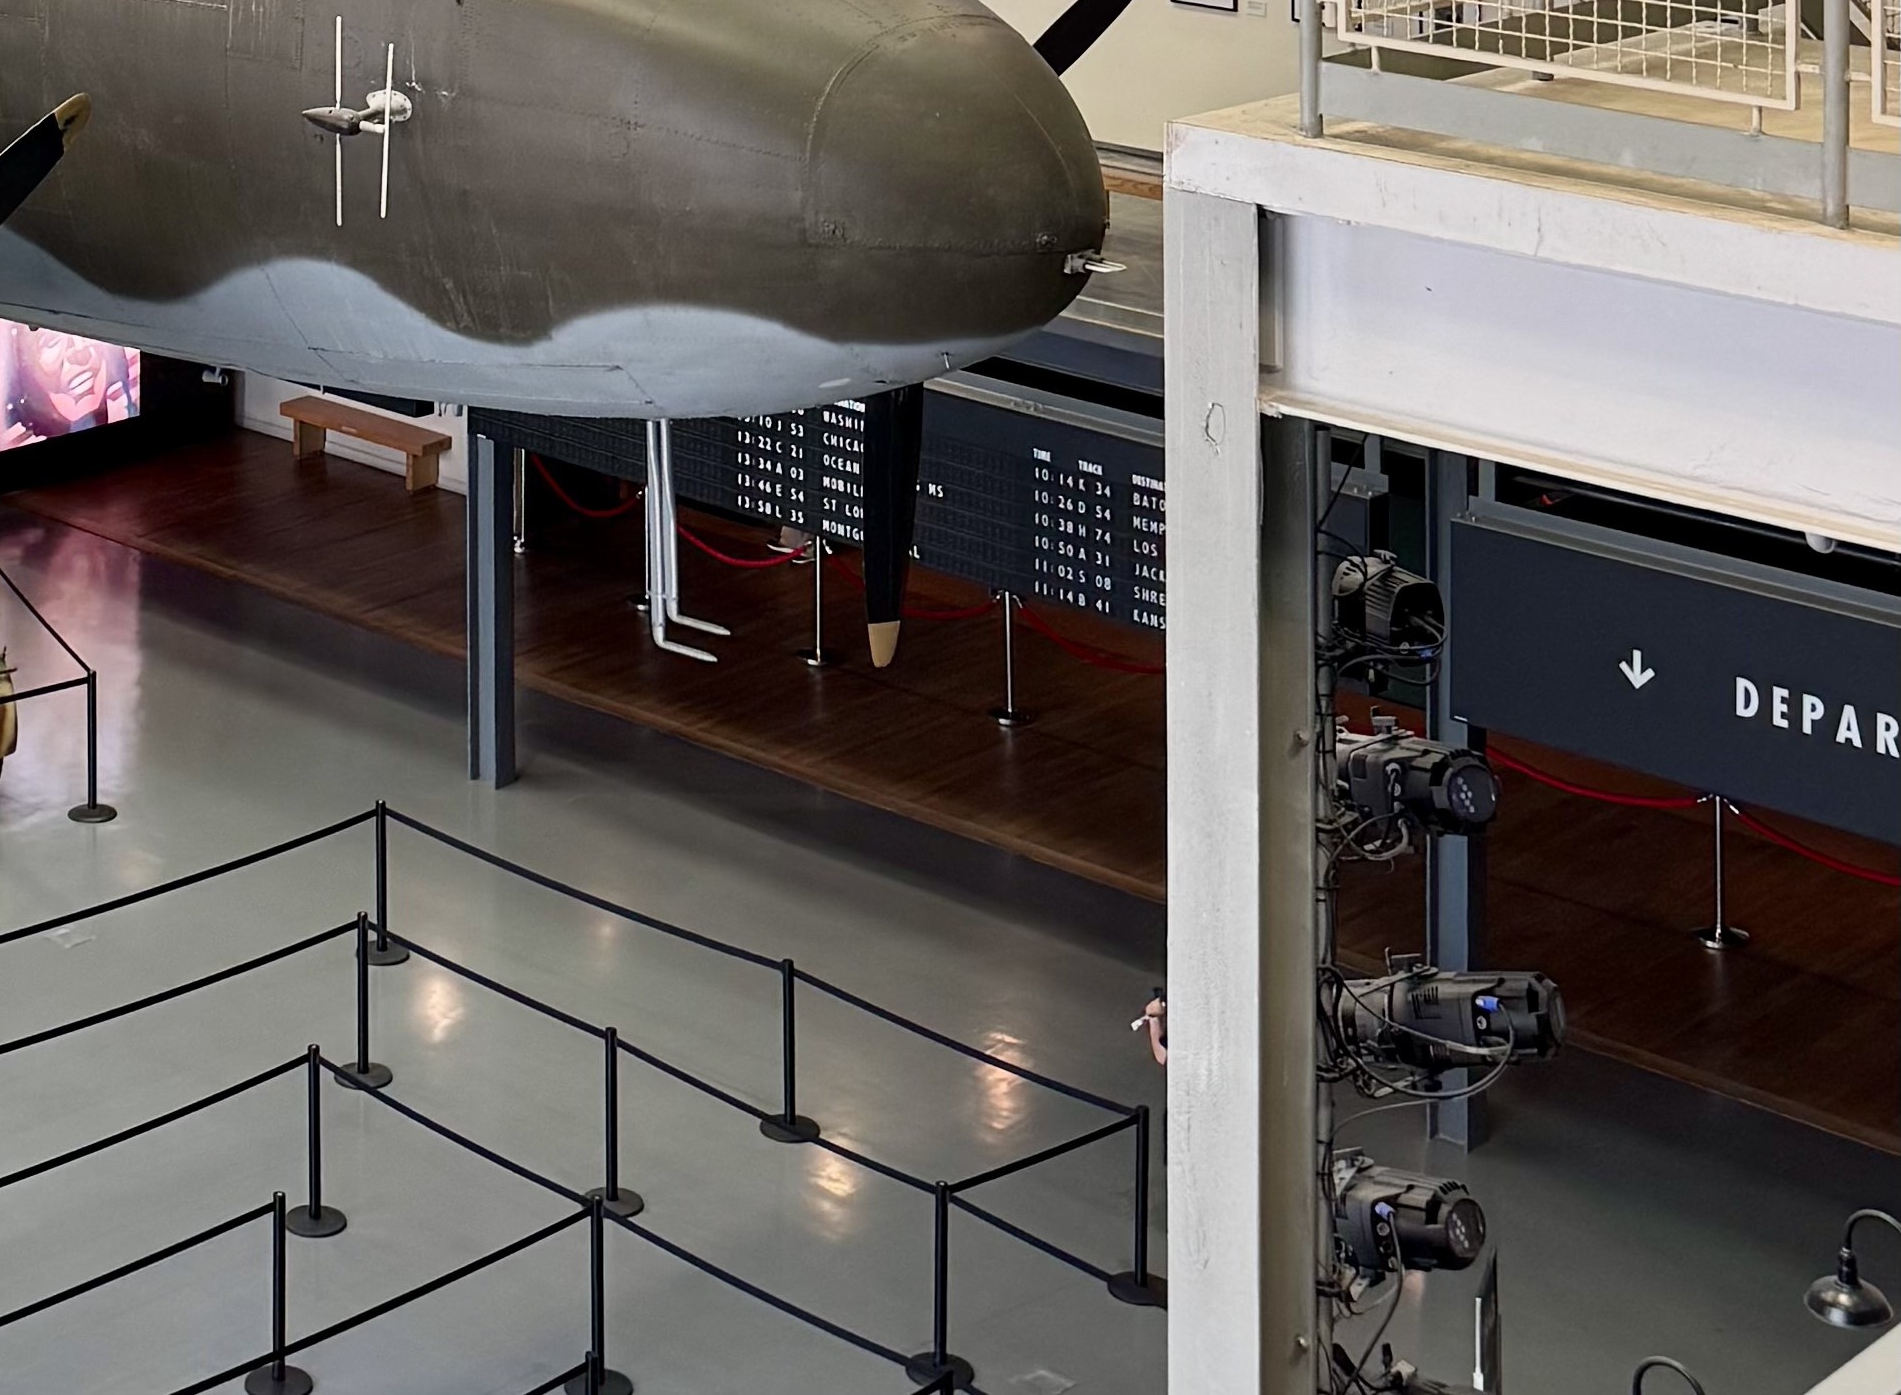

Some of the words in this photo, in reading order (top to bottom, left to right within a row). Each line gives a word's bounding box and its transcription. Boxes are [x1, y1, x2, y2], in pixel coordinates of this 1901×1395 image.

[823, 454, 860, 475] OCEAN
[1032, 447, 1051, 463] TIME
[1078, 460, 1103, 475] TRACK
[1132, 474, 1166, 491] DESTINA
[775, 462, 783, 475] A
[823, 476, 864, 497] MOBIL
[1078, 478, 1086, 492] K
[1095, 482, 1111, 498] 34
[775, 484, 783, 497] E
[823, 497, 837, 512] ST
[775, 505, 782, 518] L
[1133, 515, 1166, 536] MEMP
[1095, 528, 1111, 545] 74
[1133, 539, 1158, 557] LOS
[1078, 547, 1086, 561] A
[1095, 552, 1110, 567] 31
[1078, 570, 1086, 583] S
[1133, 586, 1166, 606] SHRE
[1095, 599, 1110, 613] 41
[1735, 676, 1901, 759] DEPAR
